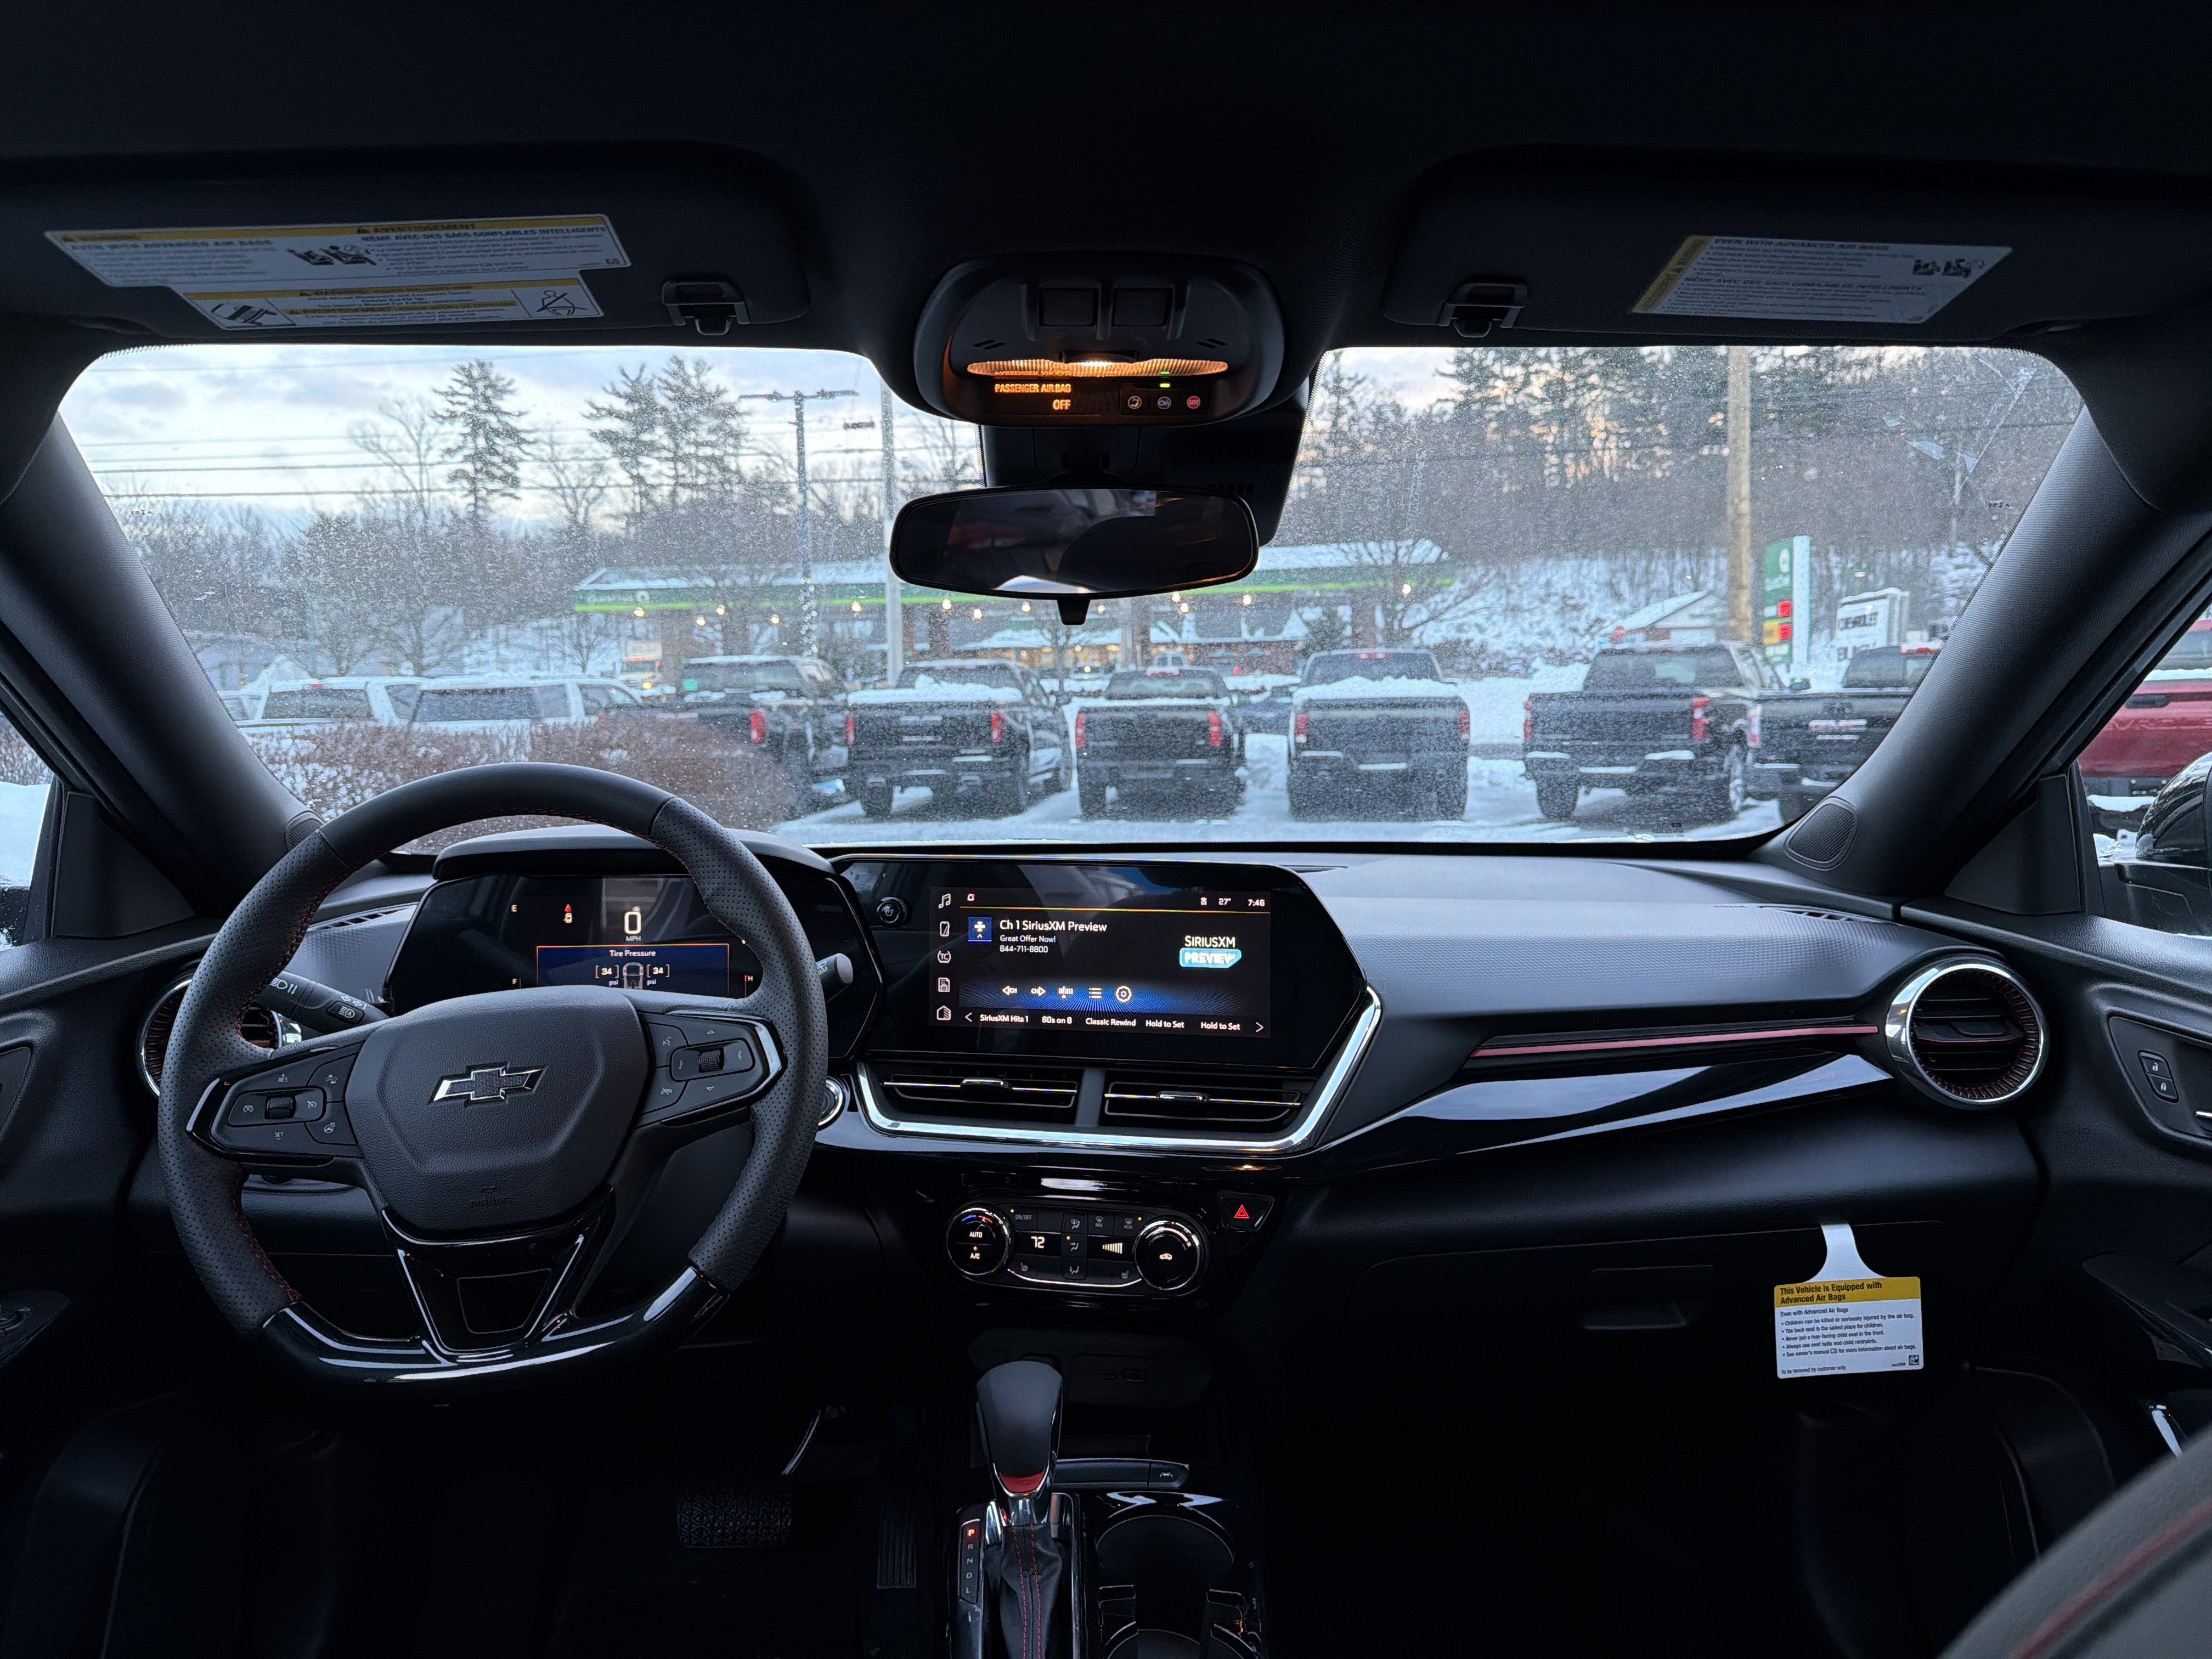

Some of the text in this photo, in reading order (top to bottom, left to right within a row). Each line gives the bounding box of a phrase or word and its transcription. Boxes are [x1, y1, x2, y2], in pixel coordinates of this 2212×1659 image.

[995, 383, 1040, 393] PASSENGER
[1041, 383, 1054, 393] AIR
[1053, 399, 1071, 410] OFF
[624, 911, 641, 934] 0
[1000, 919, 1107, 932] Ch 1 SiriusXM Preview
[1184, 935, 1235, 948] SIRIUSXM
[1000, 945, 1048, 953] 844-711-8800
[1184, 952, 1236, 964] PREVIEW
[601, 967, 613, 975] 34
[980, 1014, 1009, 1022] SiriusXM
[1042, 1015, 1056, 1024] 80s
[1146, 1019, 1163, 1028] Hold
[1030, 1236, 1045, 1249] 72
[1796, 1285, 1821, 1294] Vehicle
[1831, 1282, 1864, 1293] Equipped
[1780, 1295, 1814, 1304] Advanced
[1828, 1294, 1846, 1302] Bags
[968, 1528, 976, 1537] P
